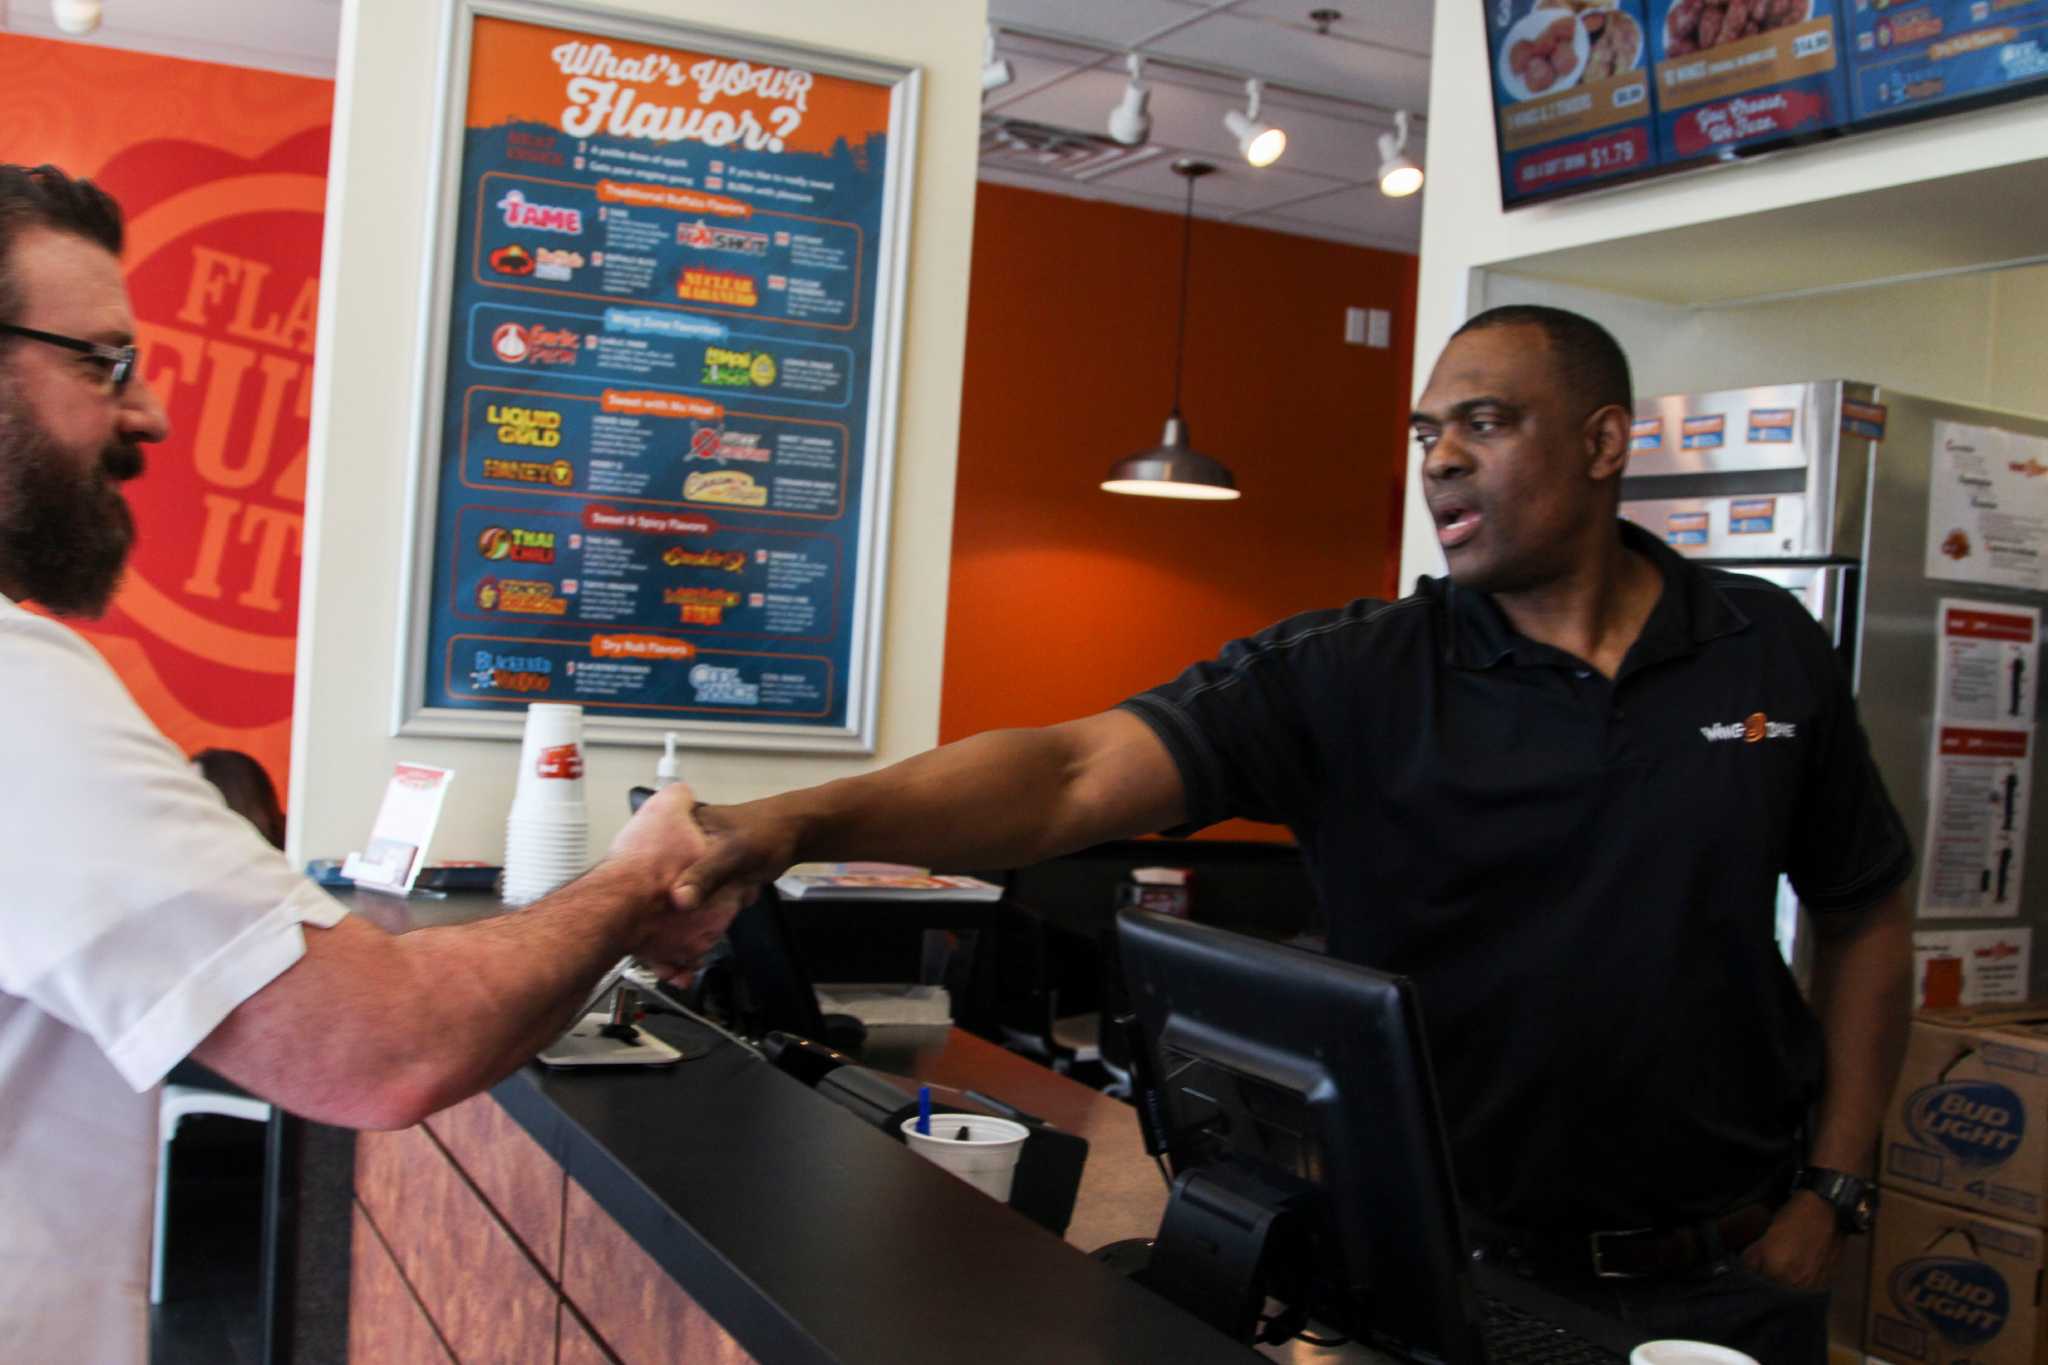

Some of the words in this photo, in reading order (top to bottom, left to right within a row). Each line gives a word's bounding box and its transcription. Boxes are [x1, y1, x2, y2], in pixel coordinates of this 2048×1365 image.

[551, 40, 686, 86] What's
[690, 59, 813, 111] YOUR
[561, 76, 801, 154] Flavor?
[1591, 141, 1634, 169] $1.79
[504, 200, 582, 235] TAME
[486, 403, 561, 429] LIQUID
[644, 398, 668, 410] with
[497, 425, 561, 448] GOLD
[511, 528, 555, 548] THAI
[592, 512, 625, 525] Sweet
[638, 515, 666, 531] Spicy
[668, 518, 708, 533] Flavors
[183, 494, 305, 612] IT
[601, 637, 622, 654] Dry
[623, 639, 645, 653] Rub
[647, 641, 688, 655] Flavors
[1940, 1092, 2009, 1127] BUD
[1926, 1110, 2017, 1150] LIGHT
[1924, 1268, 1996, 1307] BUD
[1908, 1286, 2001, 1331] LIGHT
